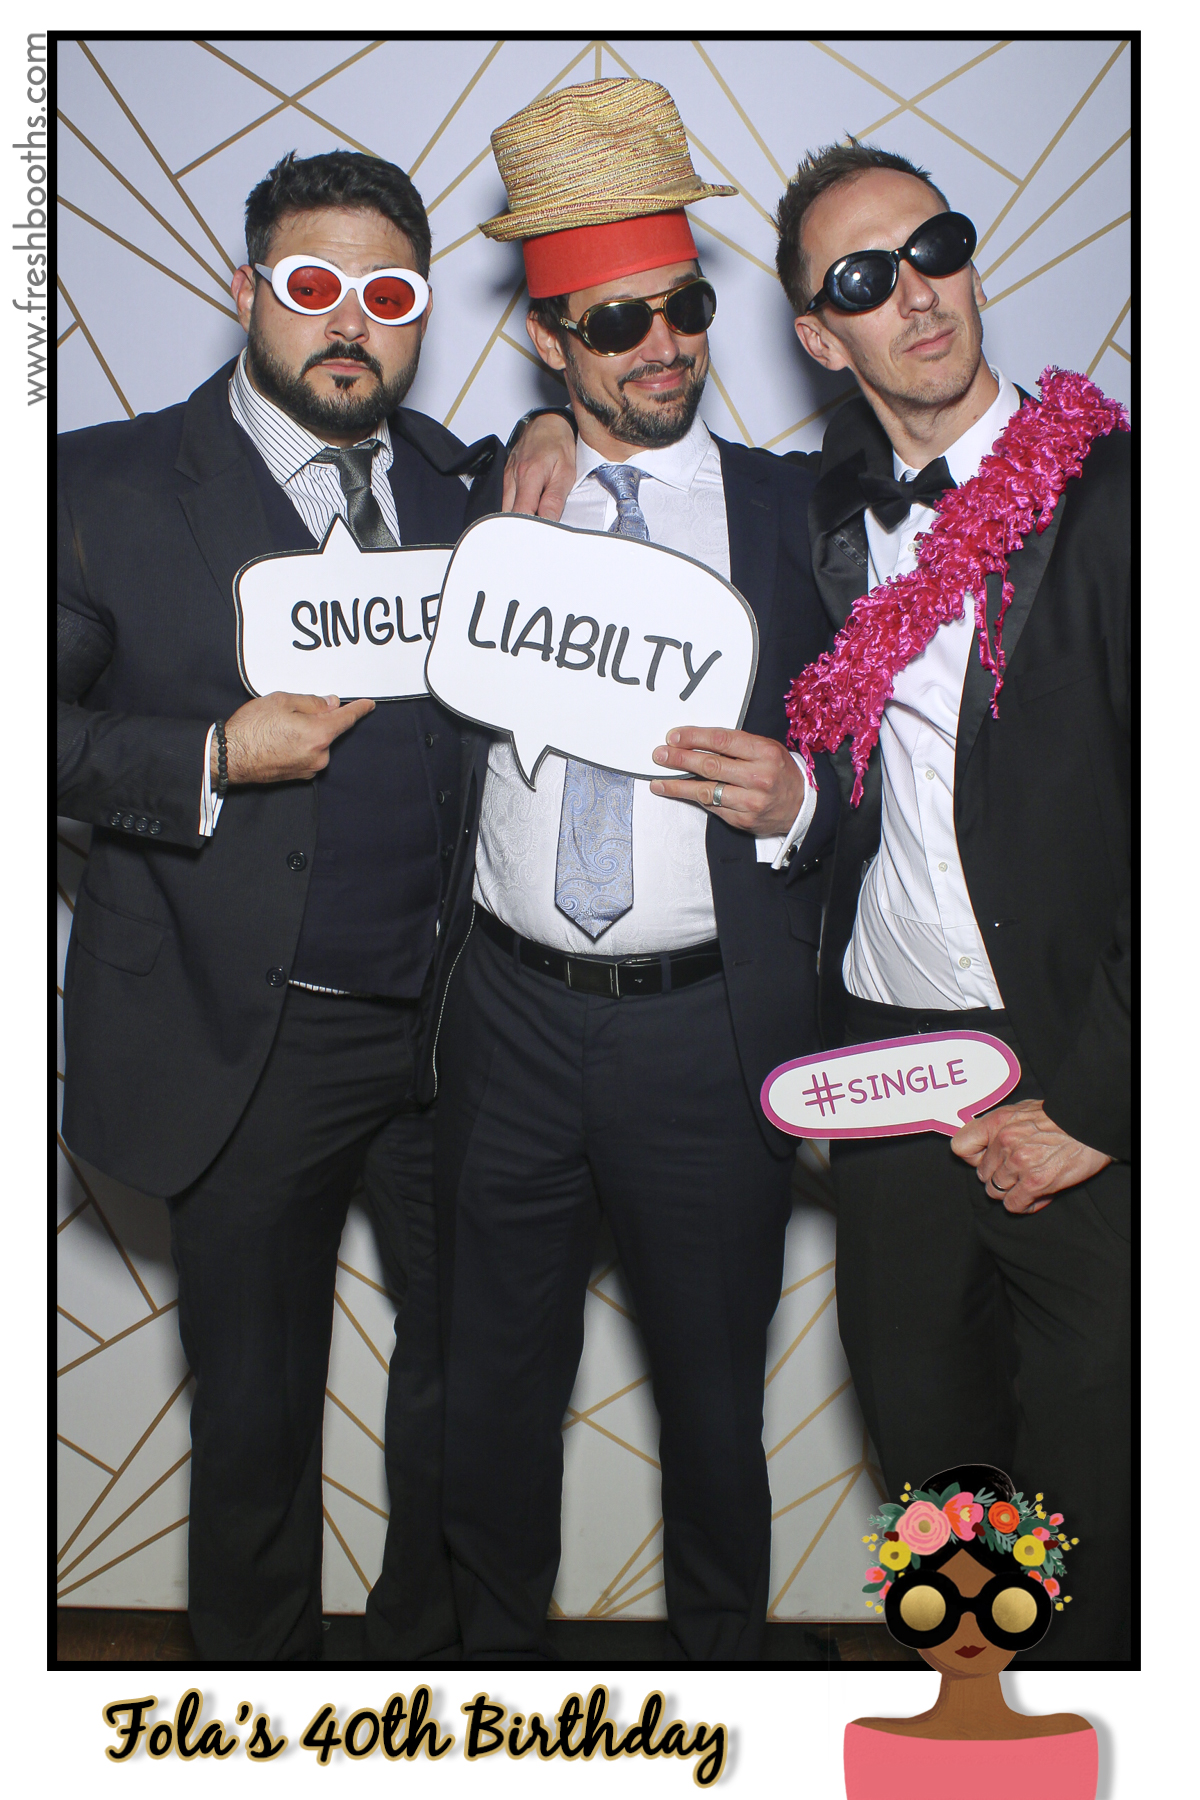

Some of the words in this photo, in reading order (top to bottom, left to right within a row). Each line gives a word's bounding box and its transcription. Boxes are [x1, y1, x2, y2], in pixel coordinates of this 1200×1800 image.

[290, 593, 441, 650] SINGLE
[467, 590, 722, 701] LIABILTY
[802, 1058, 968, 1117] #SINGLE
